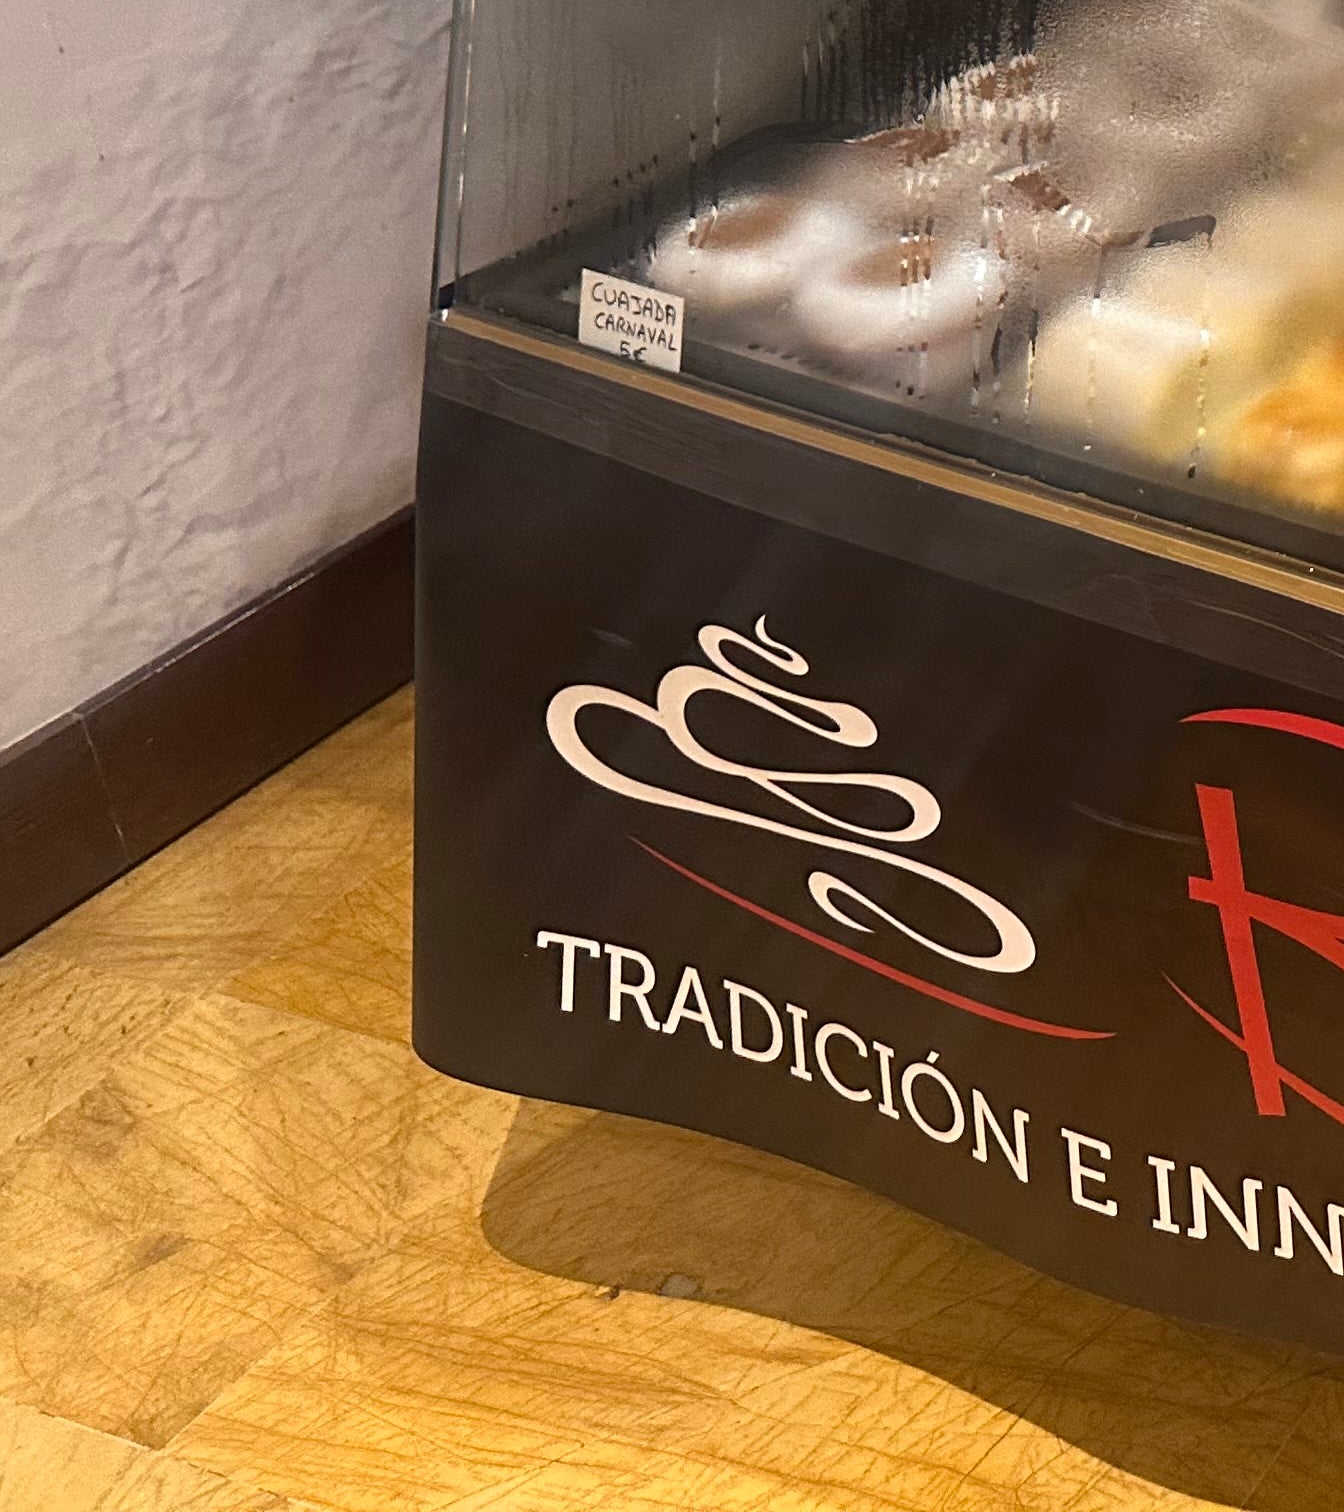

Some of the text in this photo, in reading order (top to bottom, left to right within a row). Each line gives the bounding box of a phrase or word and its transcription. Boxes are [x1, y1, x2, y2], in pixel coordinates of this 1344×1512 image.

[591, 282, 677, 327] CUAJADA
[594, 312, 678, 351] CARNAVAL
[619, 340, 648, 361] 5€
[536, 930, 1030, 1183] TRADICIÓN
[1061, 1126, 1118, 1217] E
